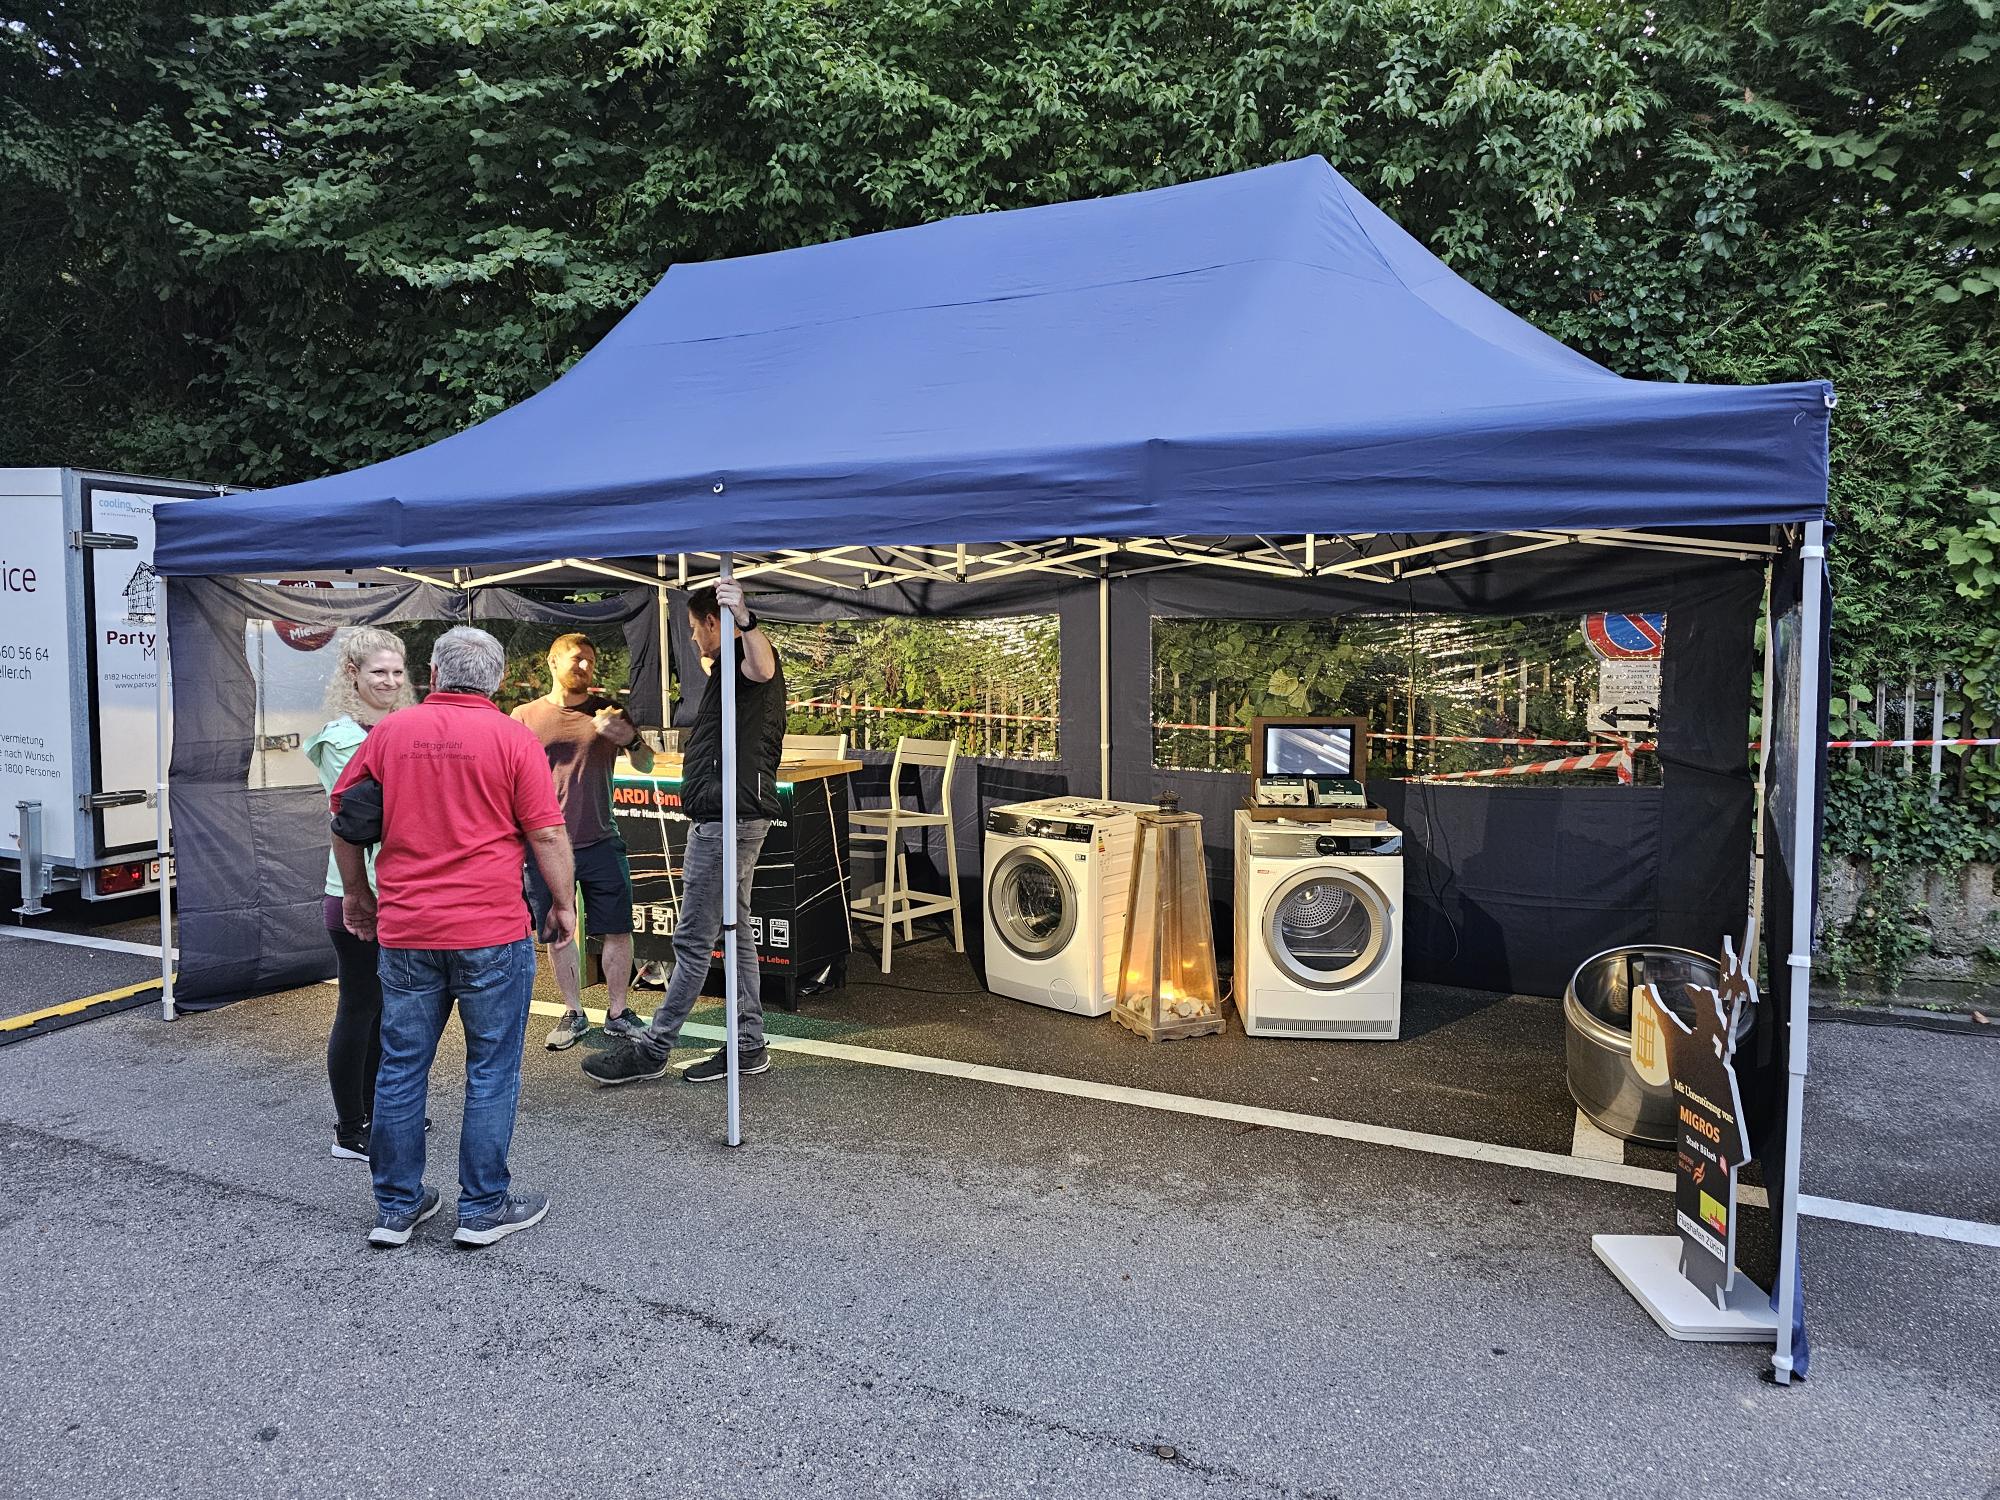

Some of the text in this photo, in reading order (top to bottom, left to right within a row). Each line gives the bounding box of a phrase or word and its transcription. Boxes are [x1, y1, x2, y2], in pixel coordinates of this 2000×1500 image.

[0, 560, 37, 593] ice
[106, 630, 156, 648] Party
[0, 645, 49, 662] 60 56 64
[0, 664, 32, 680] ller.ch
[4, 749, 23, 759] nach
[23, 750, 55, 762] Wunsch
[4, 763, 24, 774] 1800
[25, 765, 61, 778] Personen
[613, 787, 649, 805] ARDI
[612, 807, 629, 817] tner
[629, 808, 642, 818] für
[770, 818, 788, 828] rvice
[766, 955, 790, 965] Leben
[1673, 1078, 1685, 1094] Mit
[1679, 1104, 1721, 1144] MIGROS
[1678, 1213, 1705, 1243] Flughafen
[1705, 1235, 1724, 1258] Zürich
